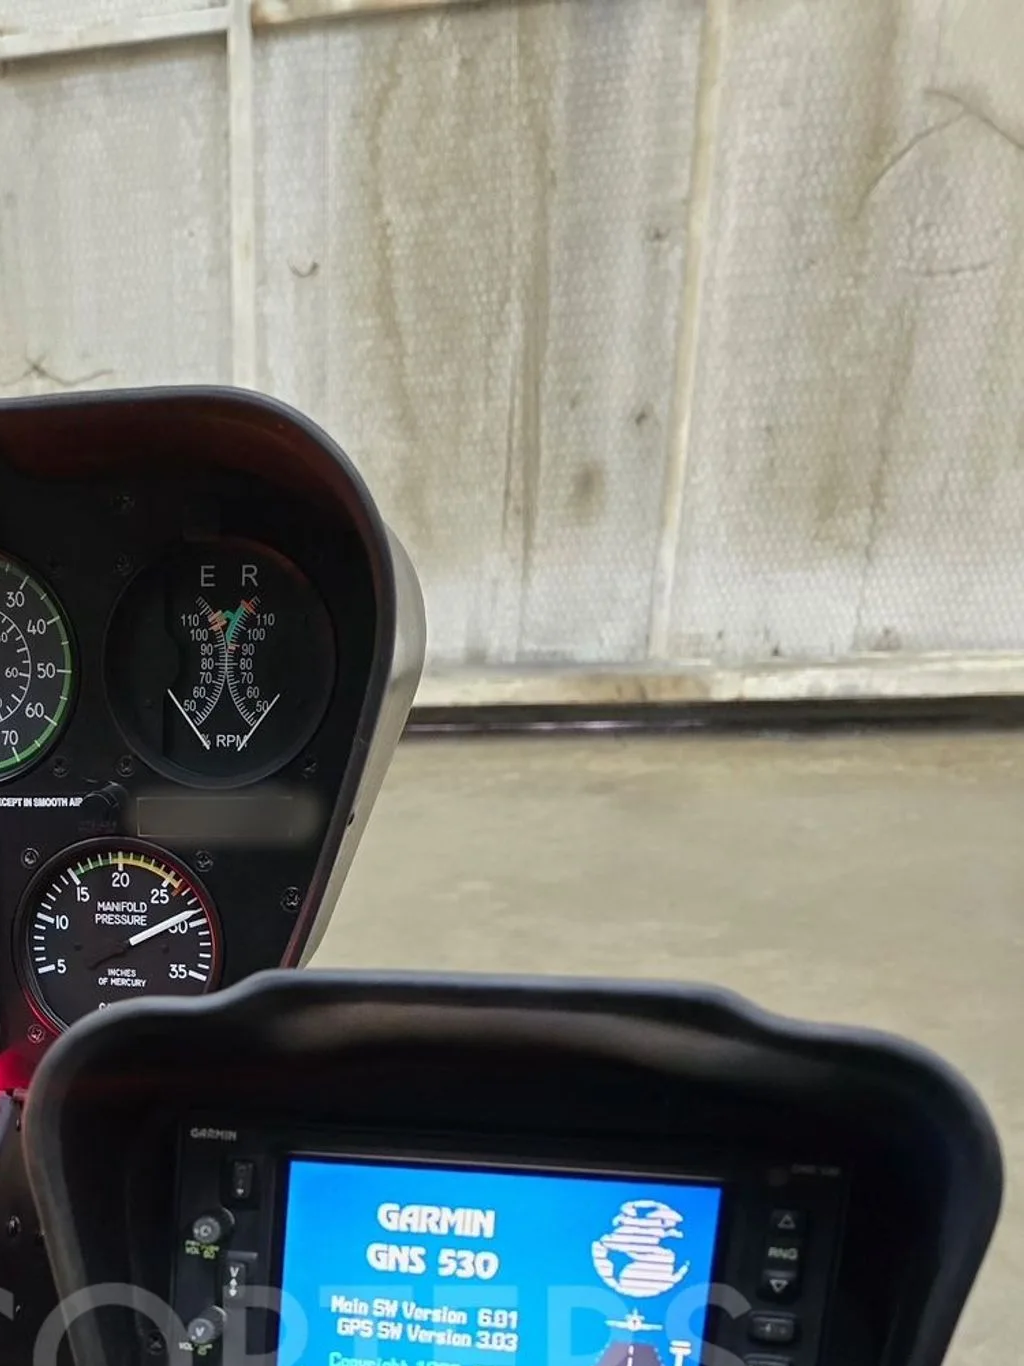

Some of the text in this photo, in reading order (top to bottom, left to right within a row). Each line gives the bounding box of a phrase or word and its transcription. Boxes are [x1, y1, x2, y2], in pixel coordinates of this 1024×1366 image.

[201, 565, 216, 587] E
[242, 565, 259, 587] R
[6, 592, 25, 607] 30
[27, 619, 46, 635] 40
[37, 663, 55, 678] 50
[26, 703, 44, 718] 60
[1, 731, 19, 745] 70
[33, 797, 67, 807] SMOOTH
[112, 873, 130, 888] 20
[76, 886, 90, 902] 15
[151, 889, 169, 904] 25
[97, 902, 147, 913] MANIFOLD
[55, 915, 69, 930] 10
[95, 914, 147, 926] PRESSURE
[108, 968, 136, 977] INCHES
[169, 964, 187, 979] 35
[111, 978, 146, 987] MERCURY
[377, 1203, 496, 1239] GARMIN
[366, 1242, 500, 1281] GNS 530
[331, 1295, 519, 1330] Main SW Version 6.01
[337, 1317, 519, 1352] GPS SW Version 3.03
